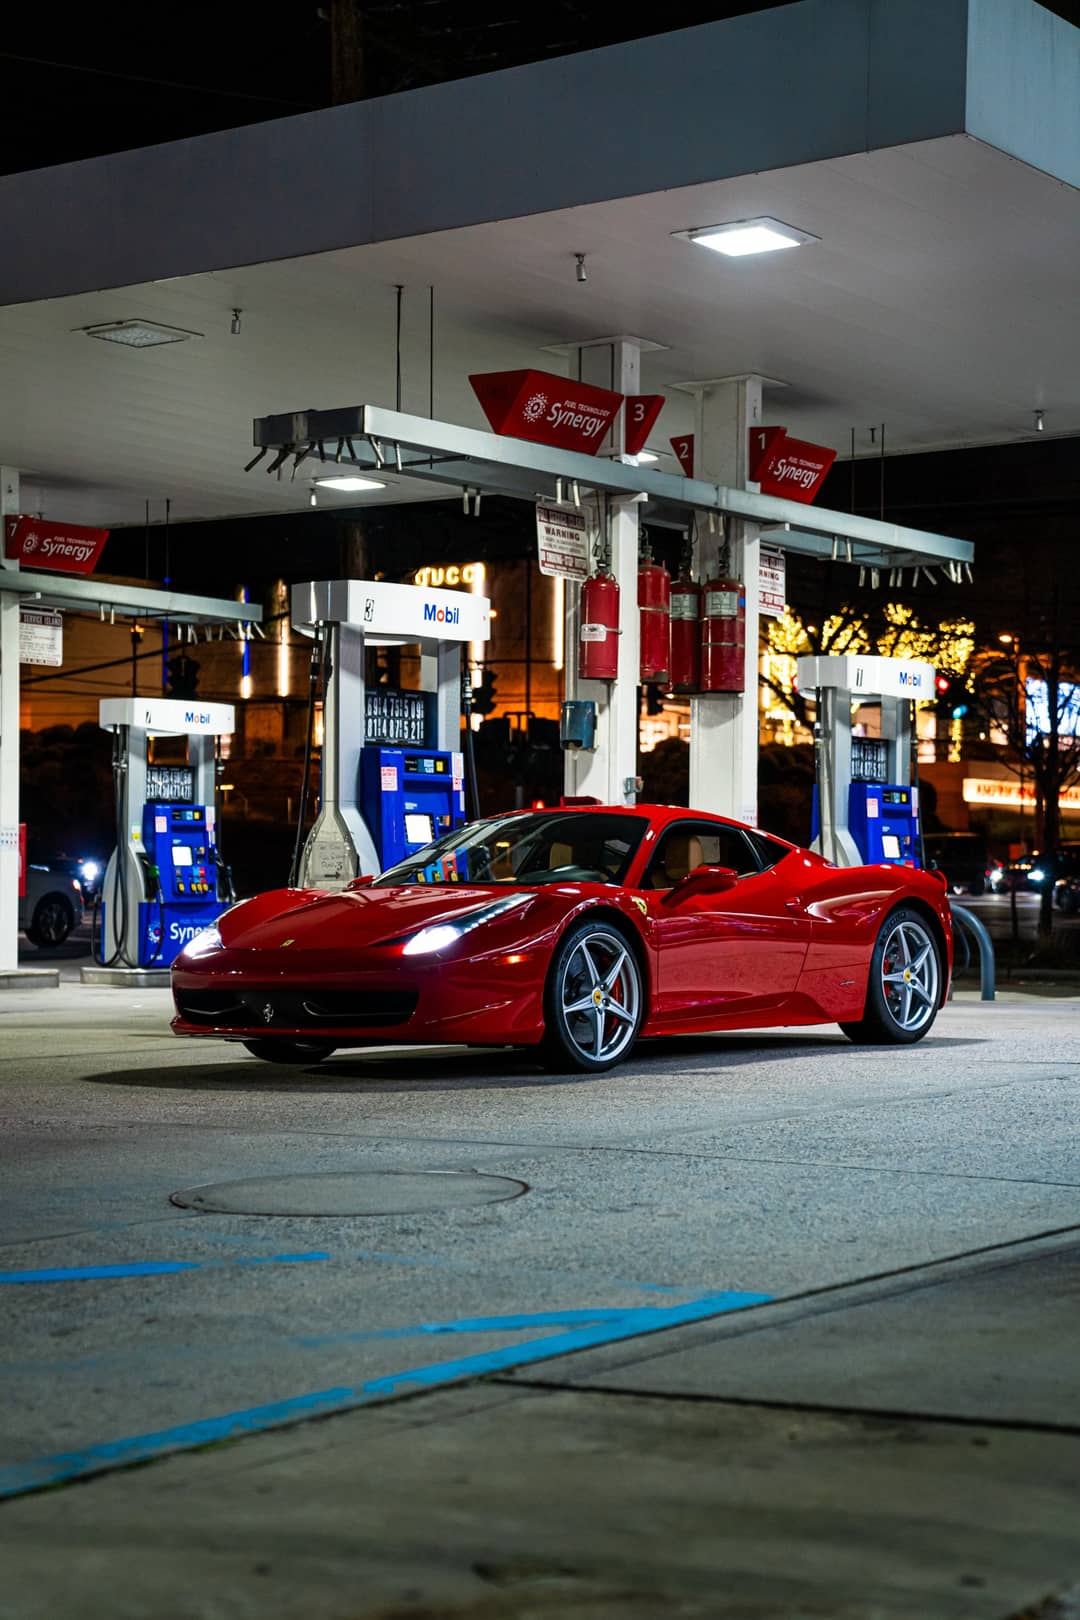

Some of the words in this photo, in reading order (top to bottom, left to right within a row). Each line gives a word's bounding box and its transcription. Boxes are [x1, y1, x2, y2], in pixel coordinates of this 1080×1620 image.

[564, 400, 576, 409] FUEL
[578, 404, 610, 417] TECHNOLOGY
[634, 403, 645, 421] 3
[546, 402, 606, 438] Synergy
[758, 432, 766, 450] 1
[679, 442, 689, 459] 2
[773, 458, 820, 489] Synergy
[9, 523, 18, 537] 7
[544, 526, 581, 541] WARNING
[40, 538, 94, 562] Synergy
[759, 569, 779, 581] RNING
[364, 599, 374, 622] 3
[424, 603, 459, 625] Mobil
[899, 671, 922, 687] Mobil
[185, 711, 211, 724] Mobil
[170, 922, 204, 944] Syne
